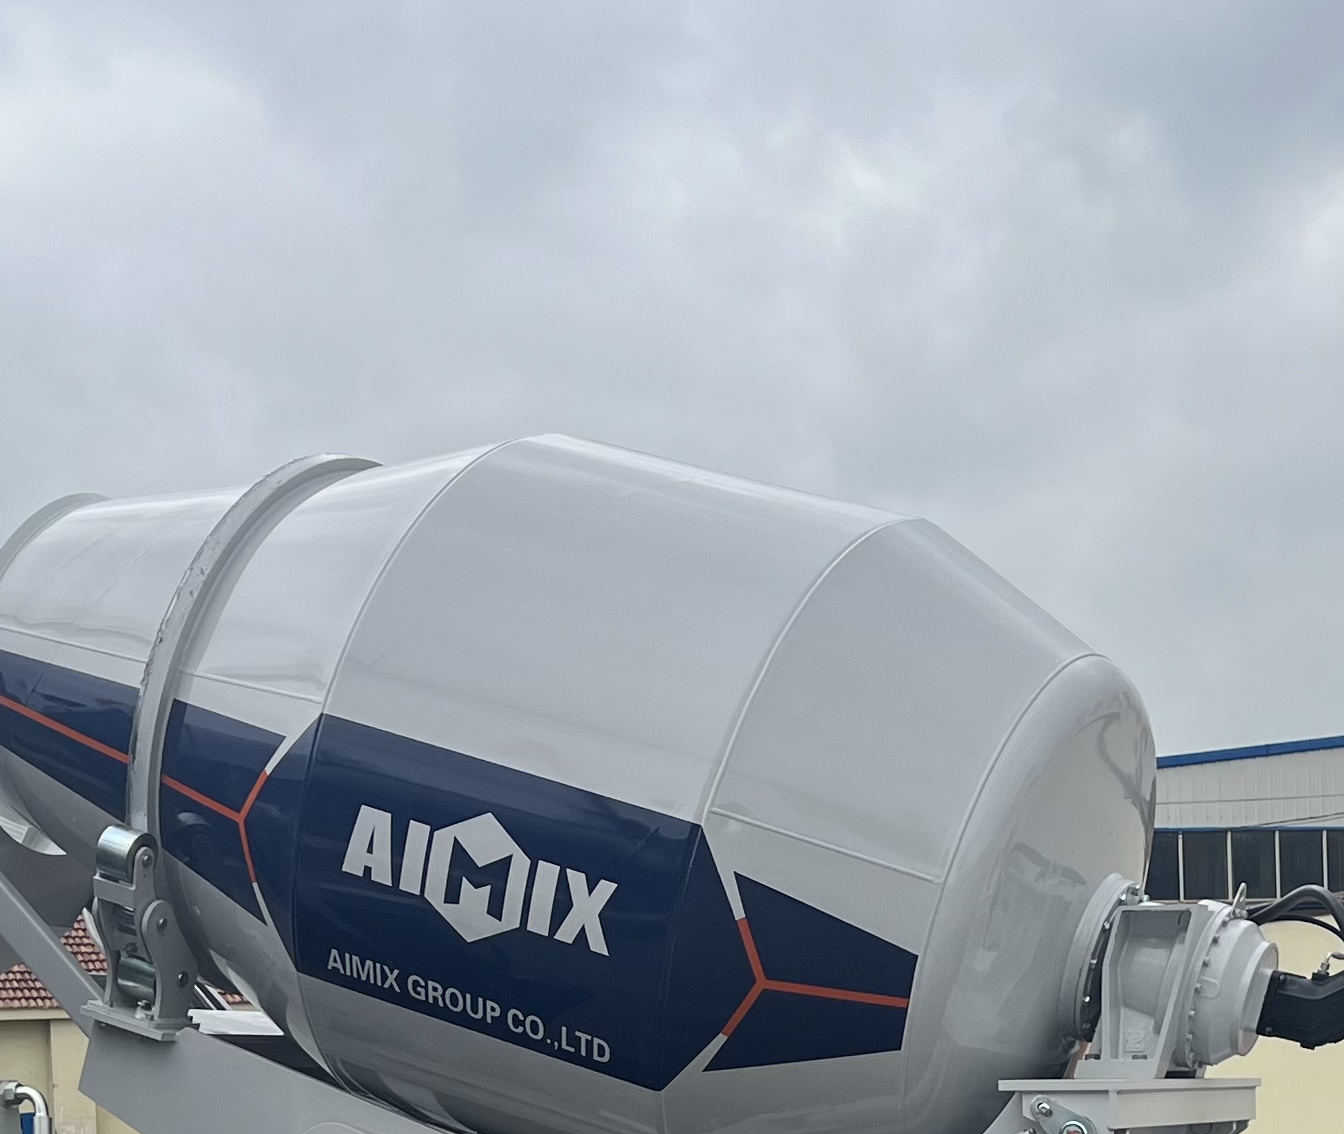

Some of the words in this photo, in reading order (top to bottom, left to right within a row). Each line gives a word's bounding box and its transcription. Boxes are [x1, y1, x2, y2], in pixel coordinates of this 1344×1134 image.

[341, 804, 618, 957] AIMIX
[327, 948, 400, 993] AIMIX
[407, 975, 501, 1023] GROUP
